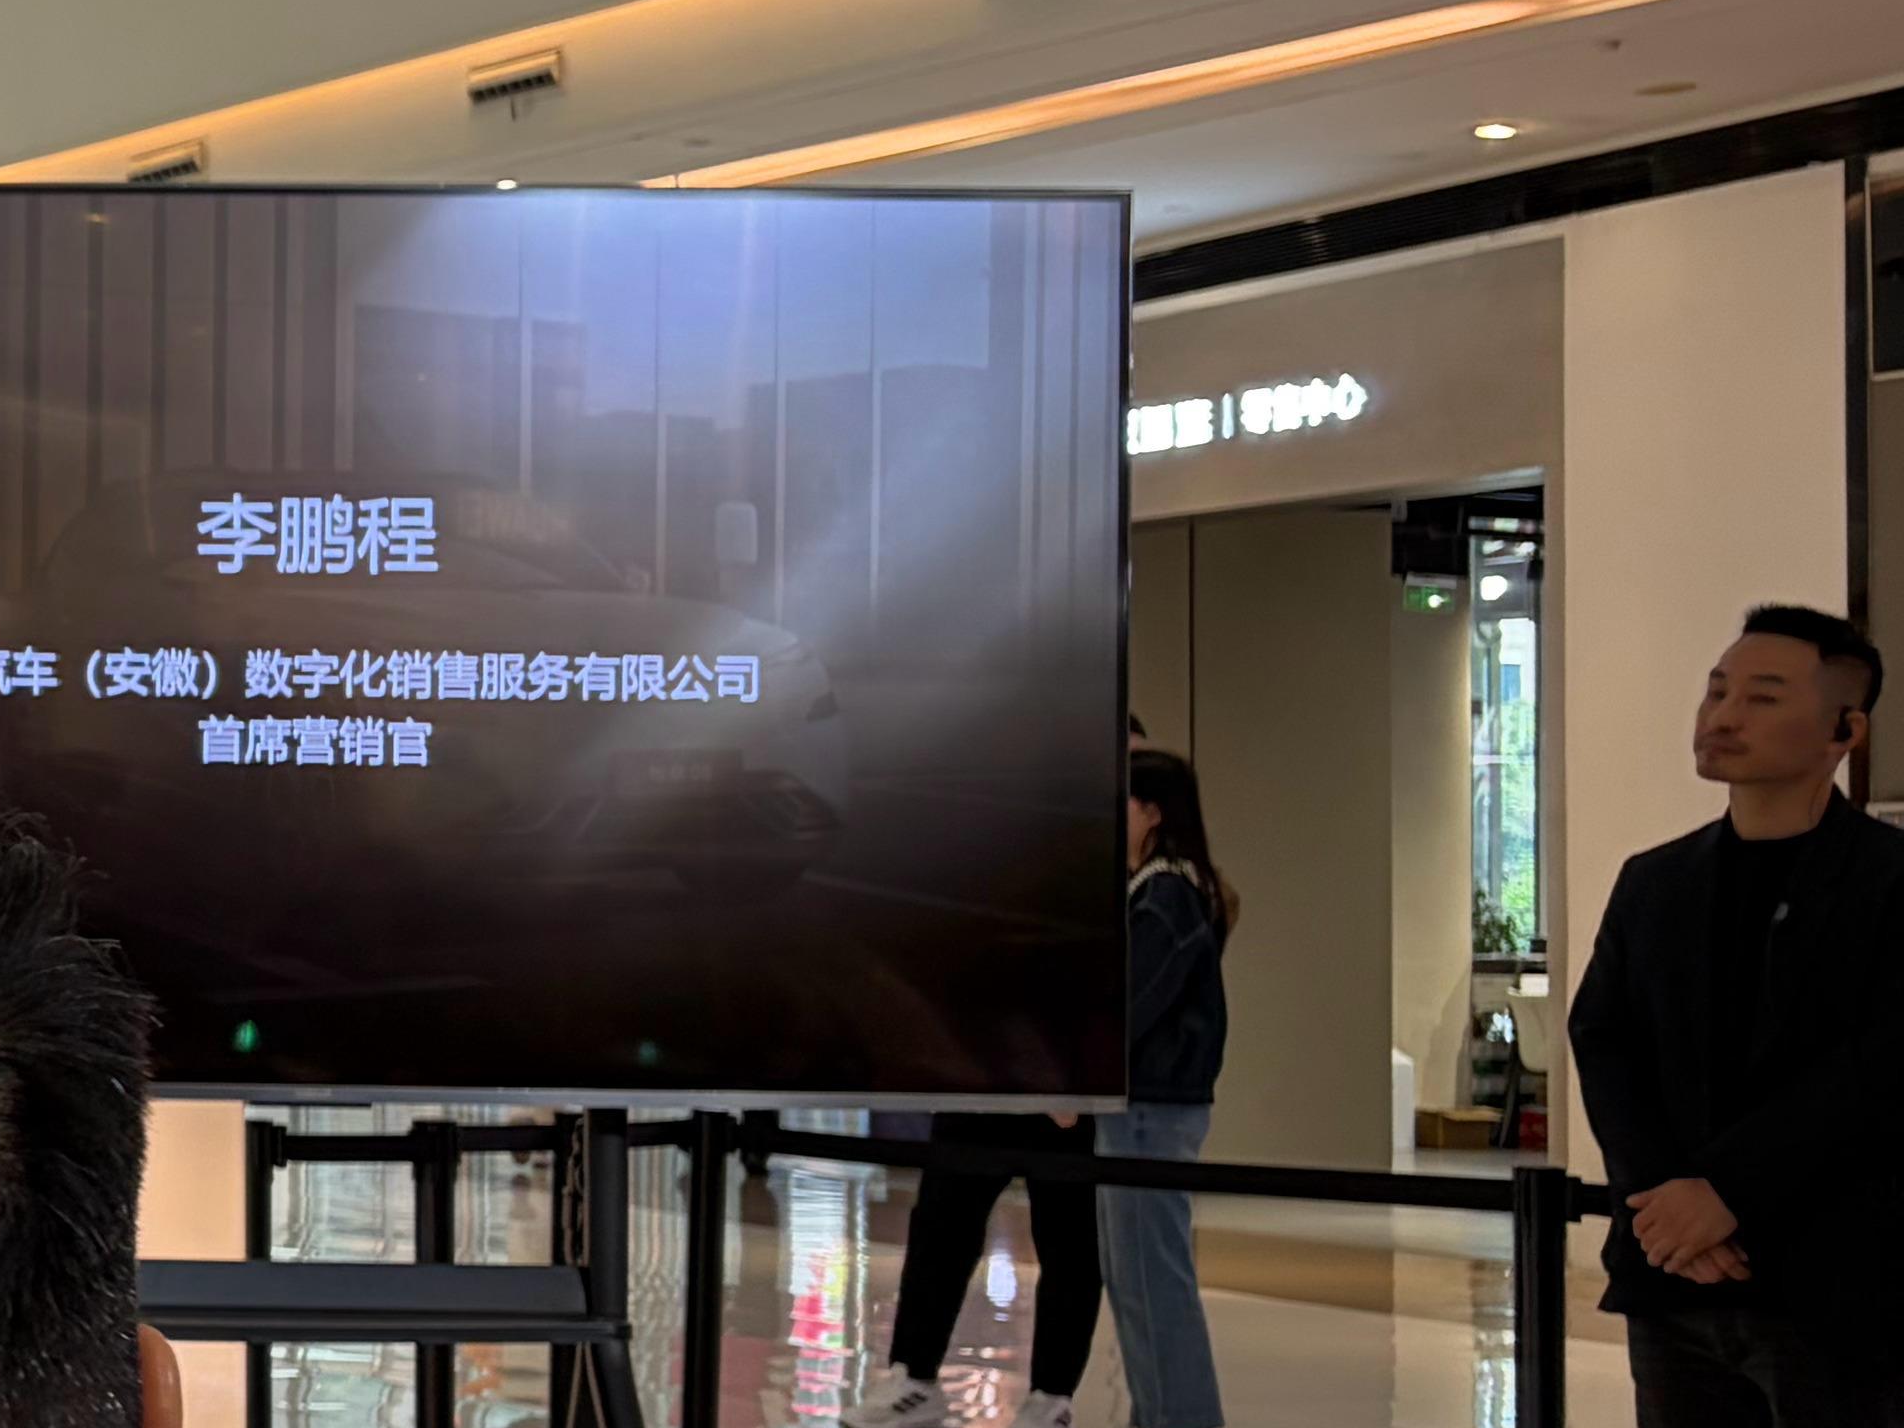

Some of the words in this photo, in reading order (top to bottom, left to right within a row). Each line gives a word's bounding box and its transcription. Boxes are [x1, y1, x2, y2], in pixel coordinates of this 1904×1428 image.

[197, 492, 439, 575] 李鹏程
[198, 715, 434, 767] 首席营销官
